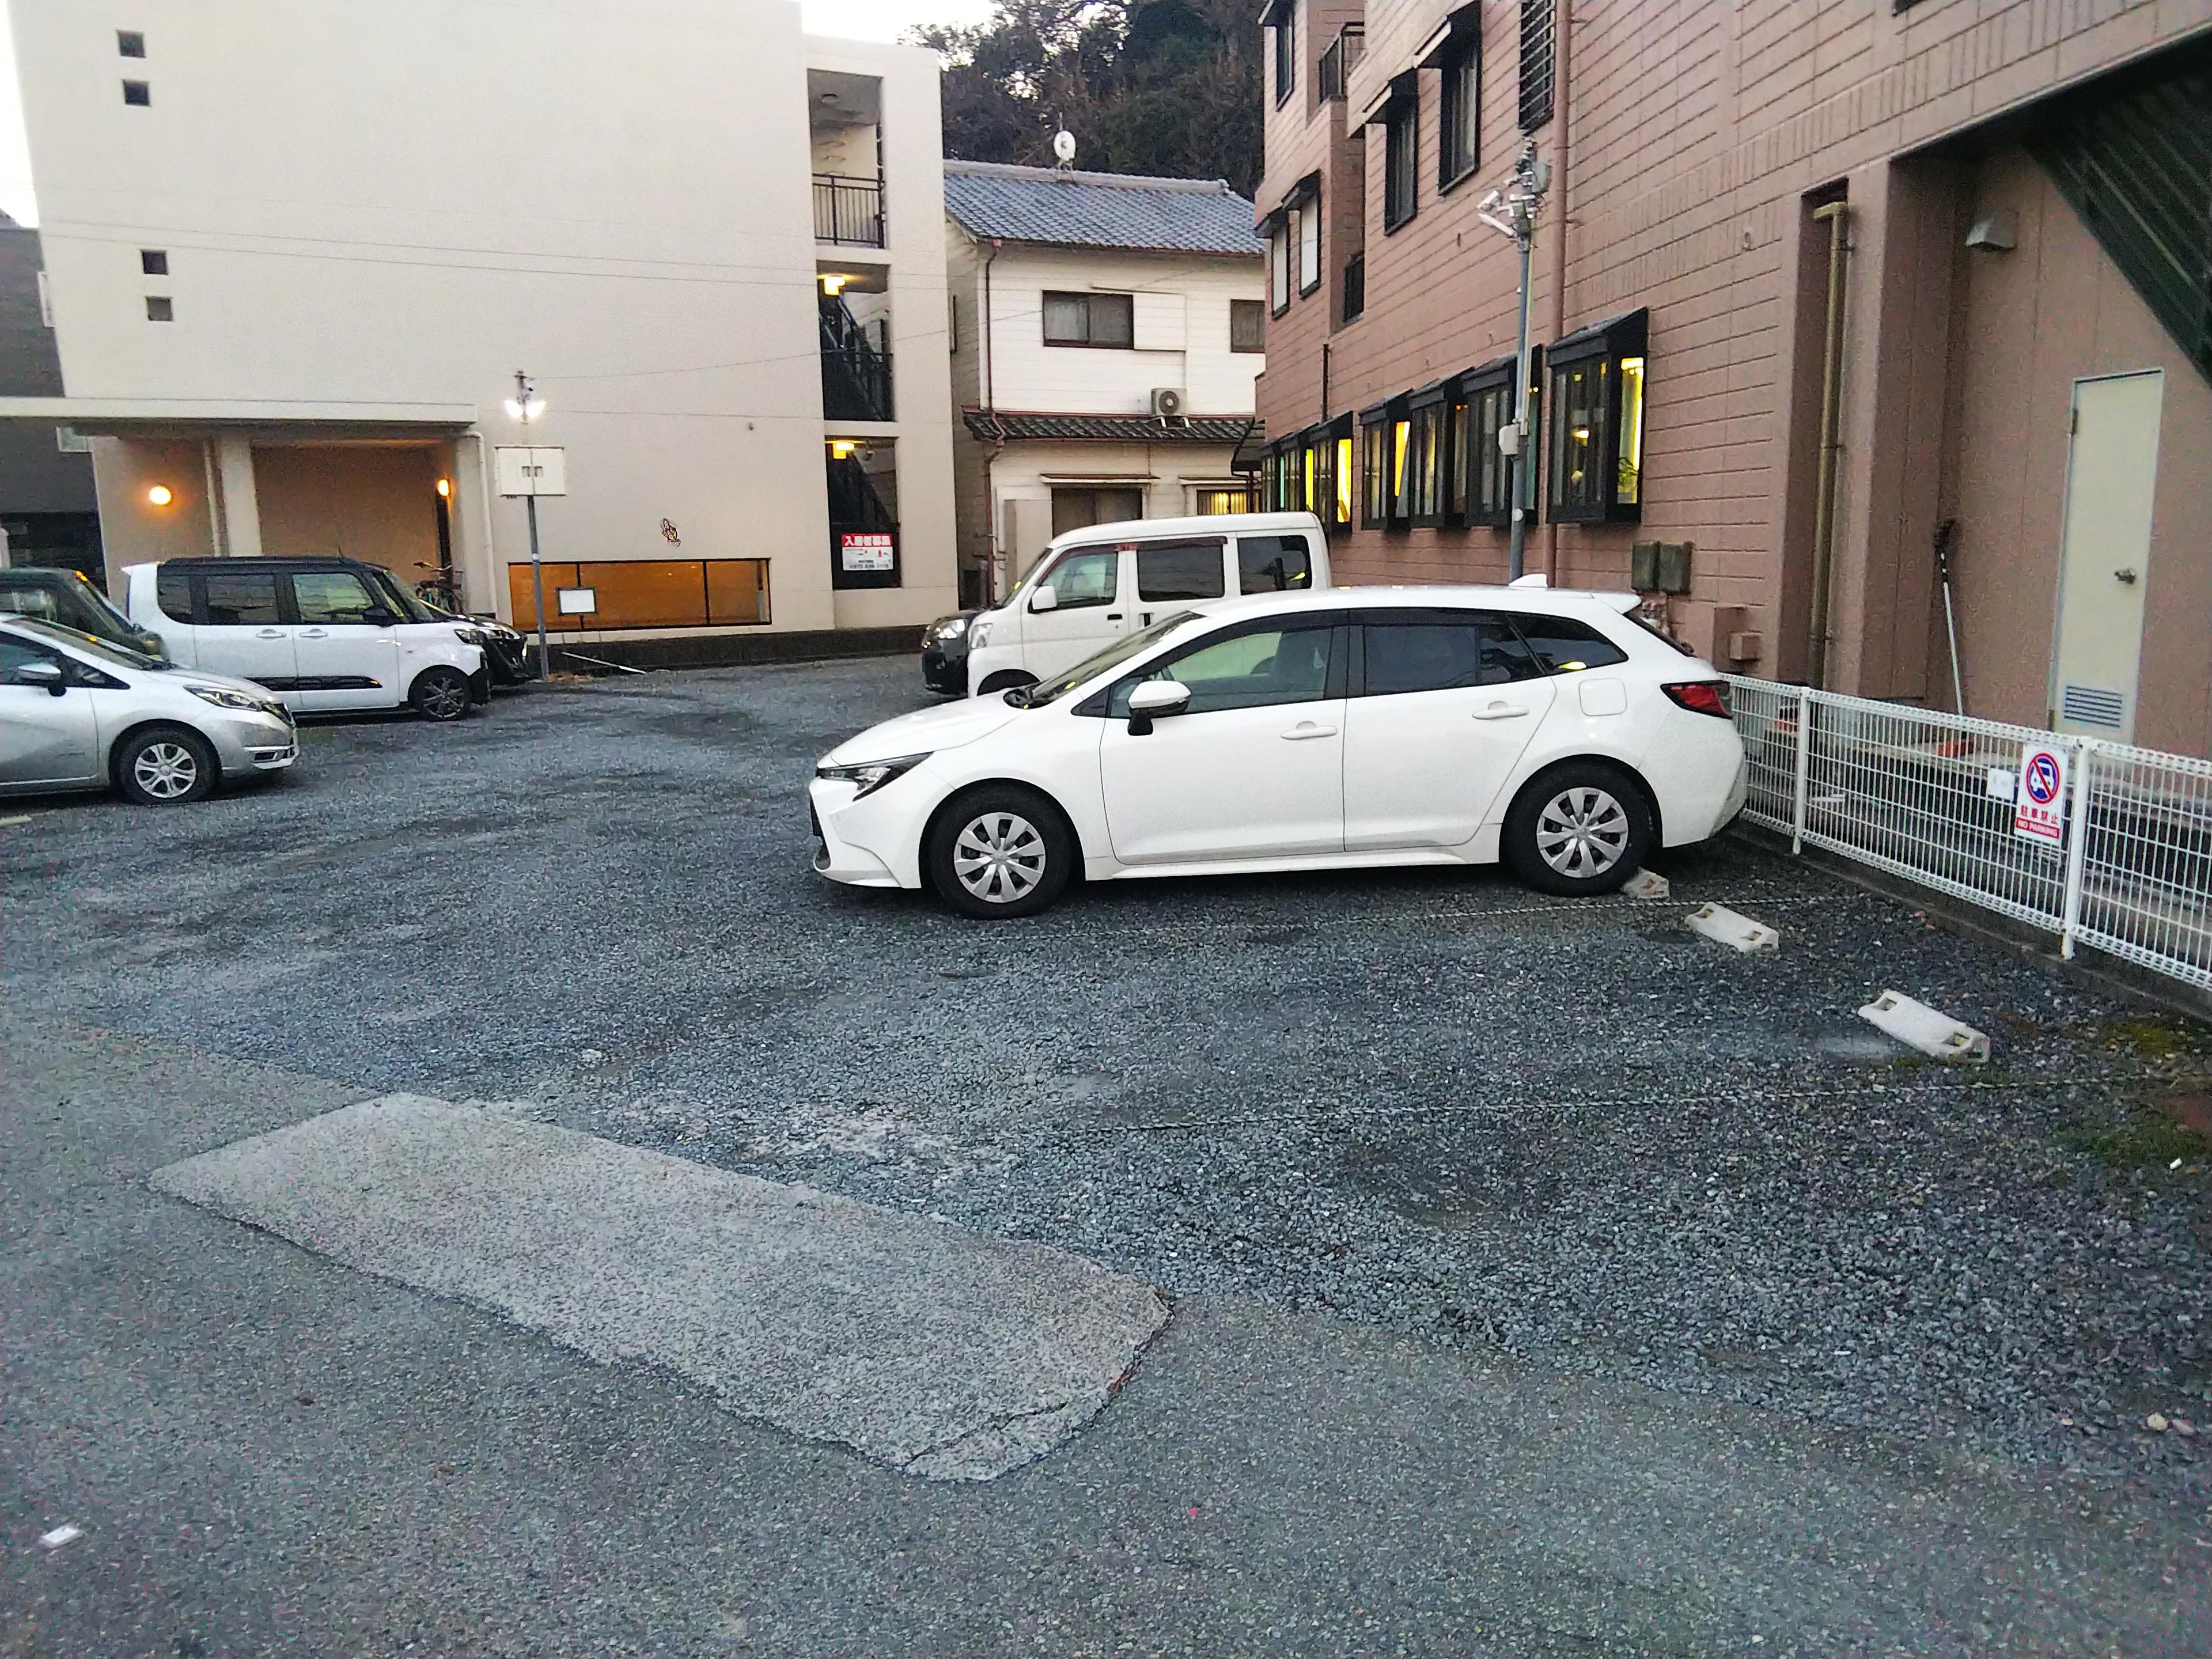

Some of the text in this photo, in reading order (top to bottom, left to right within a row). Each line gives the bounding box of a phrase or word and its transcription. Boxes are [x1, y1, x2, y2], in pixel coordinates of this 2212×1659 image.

[2020, 805, 2058, 825] 駐車禁止
[2017, 819, 2058, 838] NO PARKING
